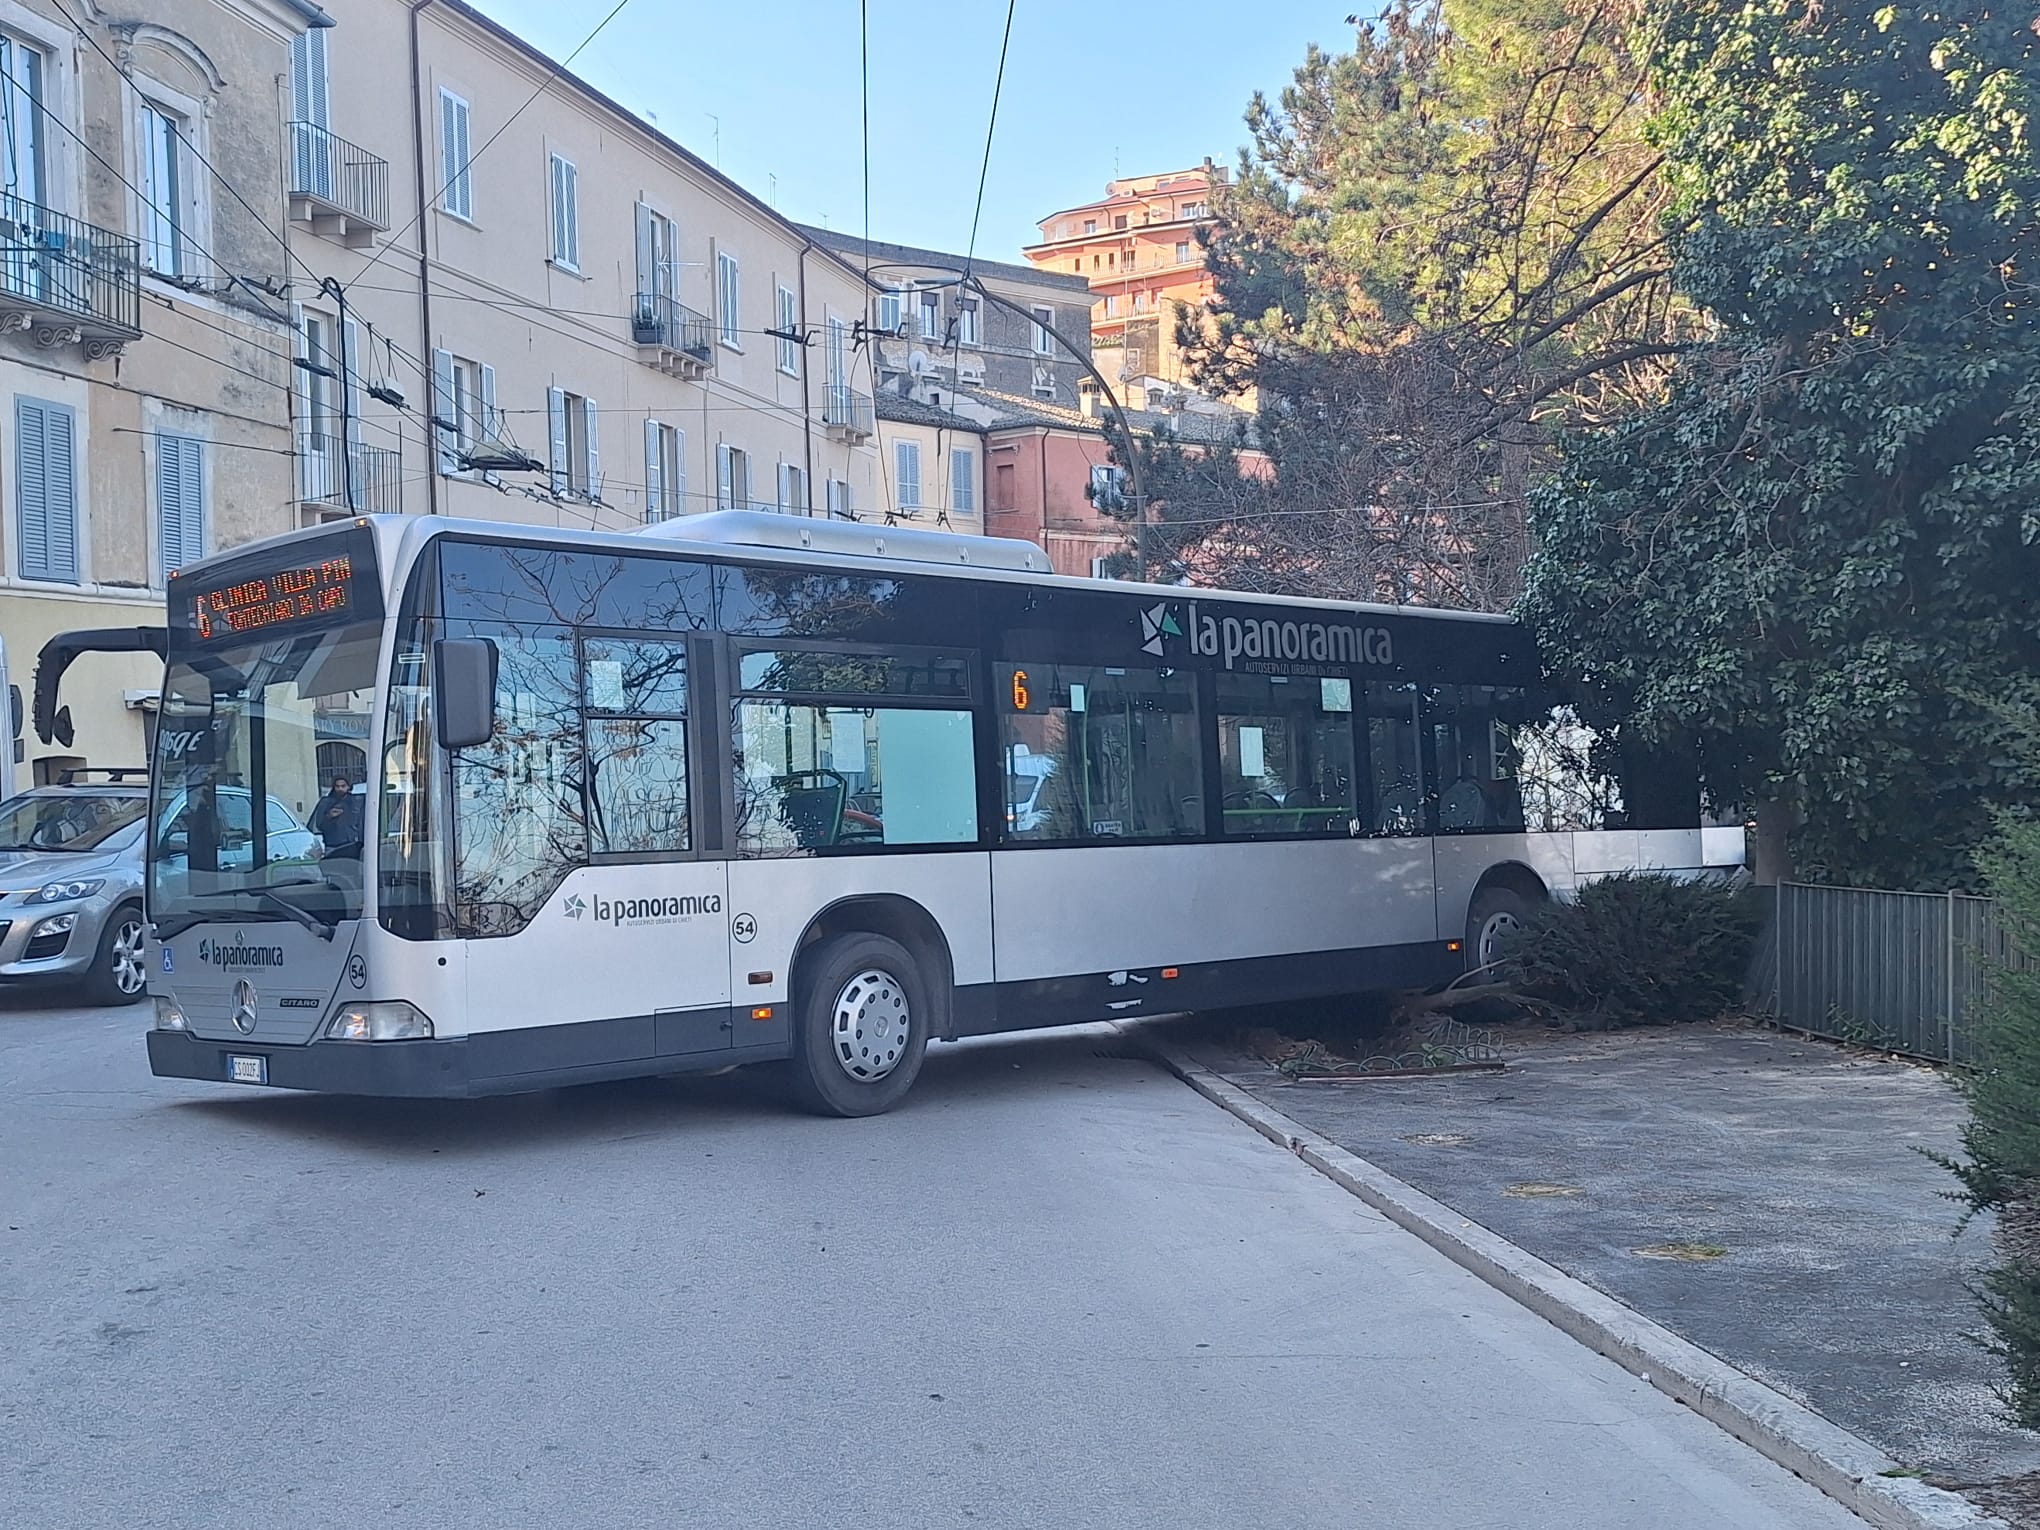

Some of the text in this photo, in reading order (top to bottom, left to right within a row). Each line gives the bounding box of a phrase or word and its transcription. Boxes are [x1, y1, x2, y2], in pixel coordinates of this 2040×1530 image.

[210, 579, 269, 612] CLINICA
[271, 567, 318, 595] VILLA
[1188, 600, 1394, 671] la panoramica
[1012, 670, 1030, 710] 6
[593, 893, 721, 927] la panoramica
[735, 921, 754, 935] 54
[212, 938, 284, 973] la panoramica
[351, 964, 365, 980] 54
[281, 999, 318, 1008] CITARO
